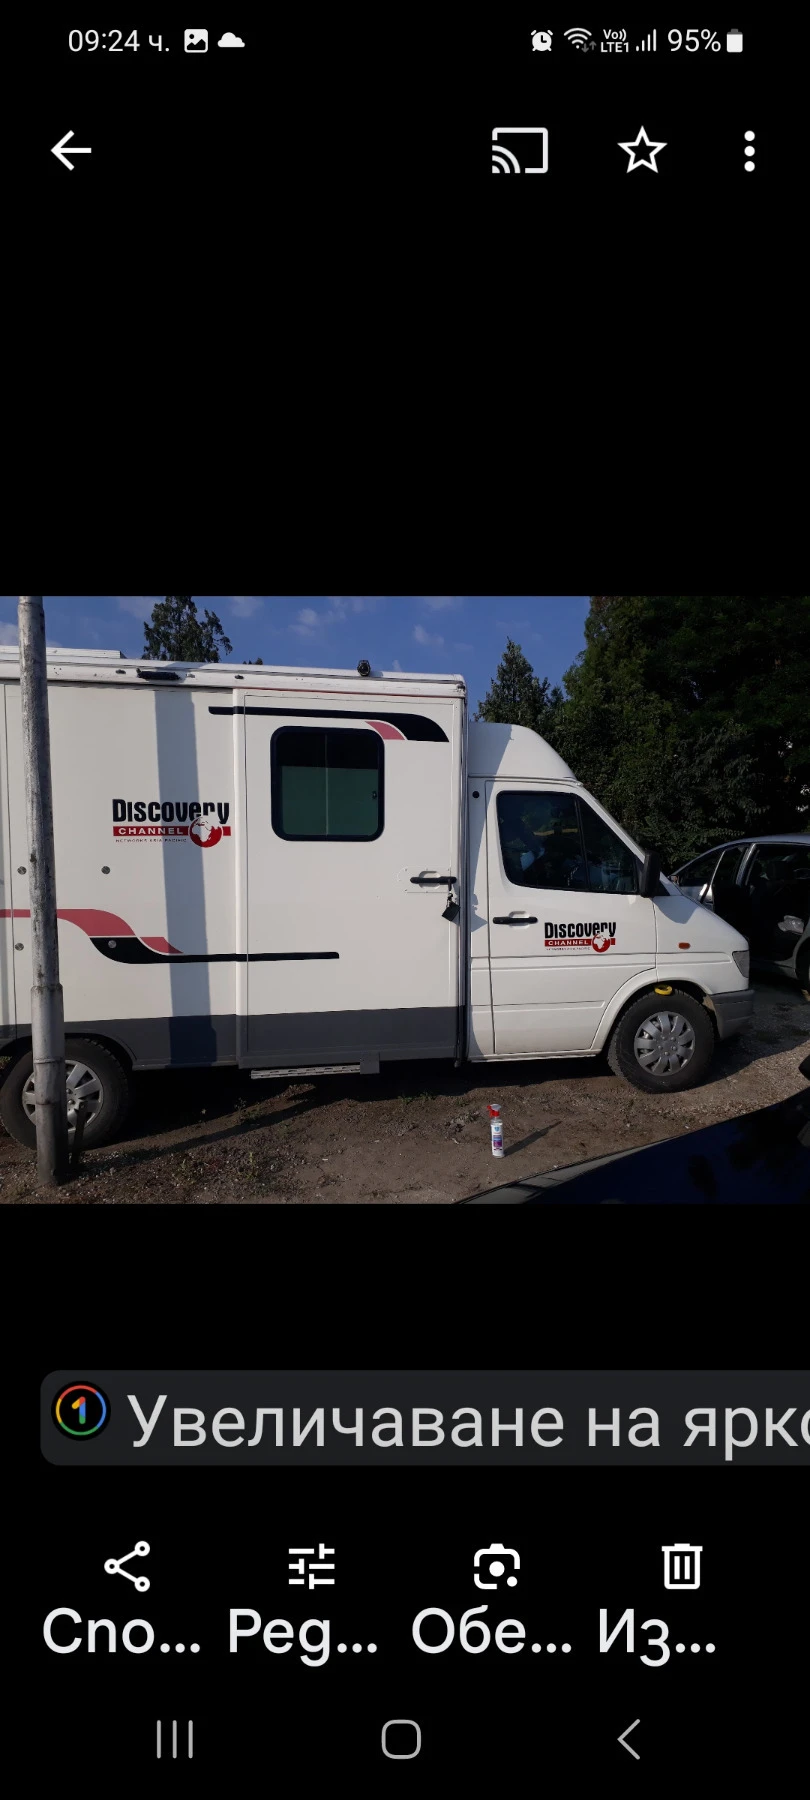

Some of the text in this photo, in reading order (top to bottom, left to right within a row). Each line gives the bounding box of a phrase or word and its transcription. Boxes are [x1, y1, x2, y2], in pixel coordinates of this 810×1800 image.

[112, 798, 230, 824] Discovery
[118, 827, 184, 835] CHANNEL
[544, 922, 616, 938] Discovery
